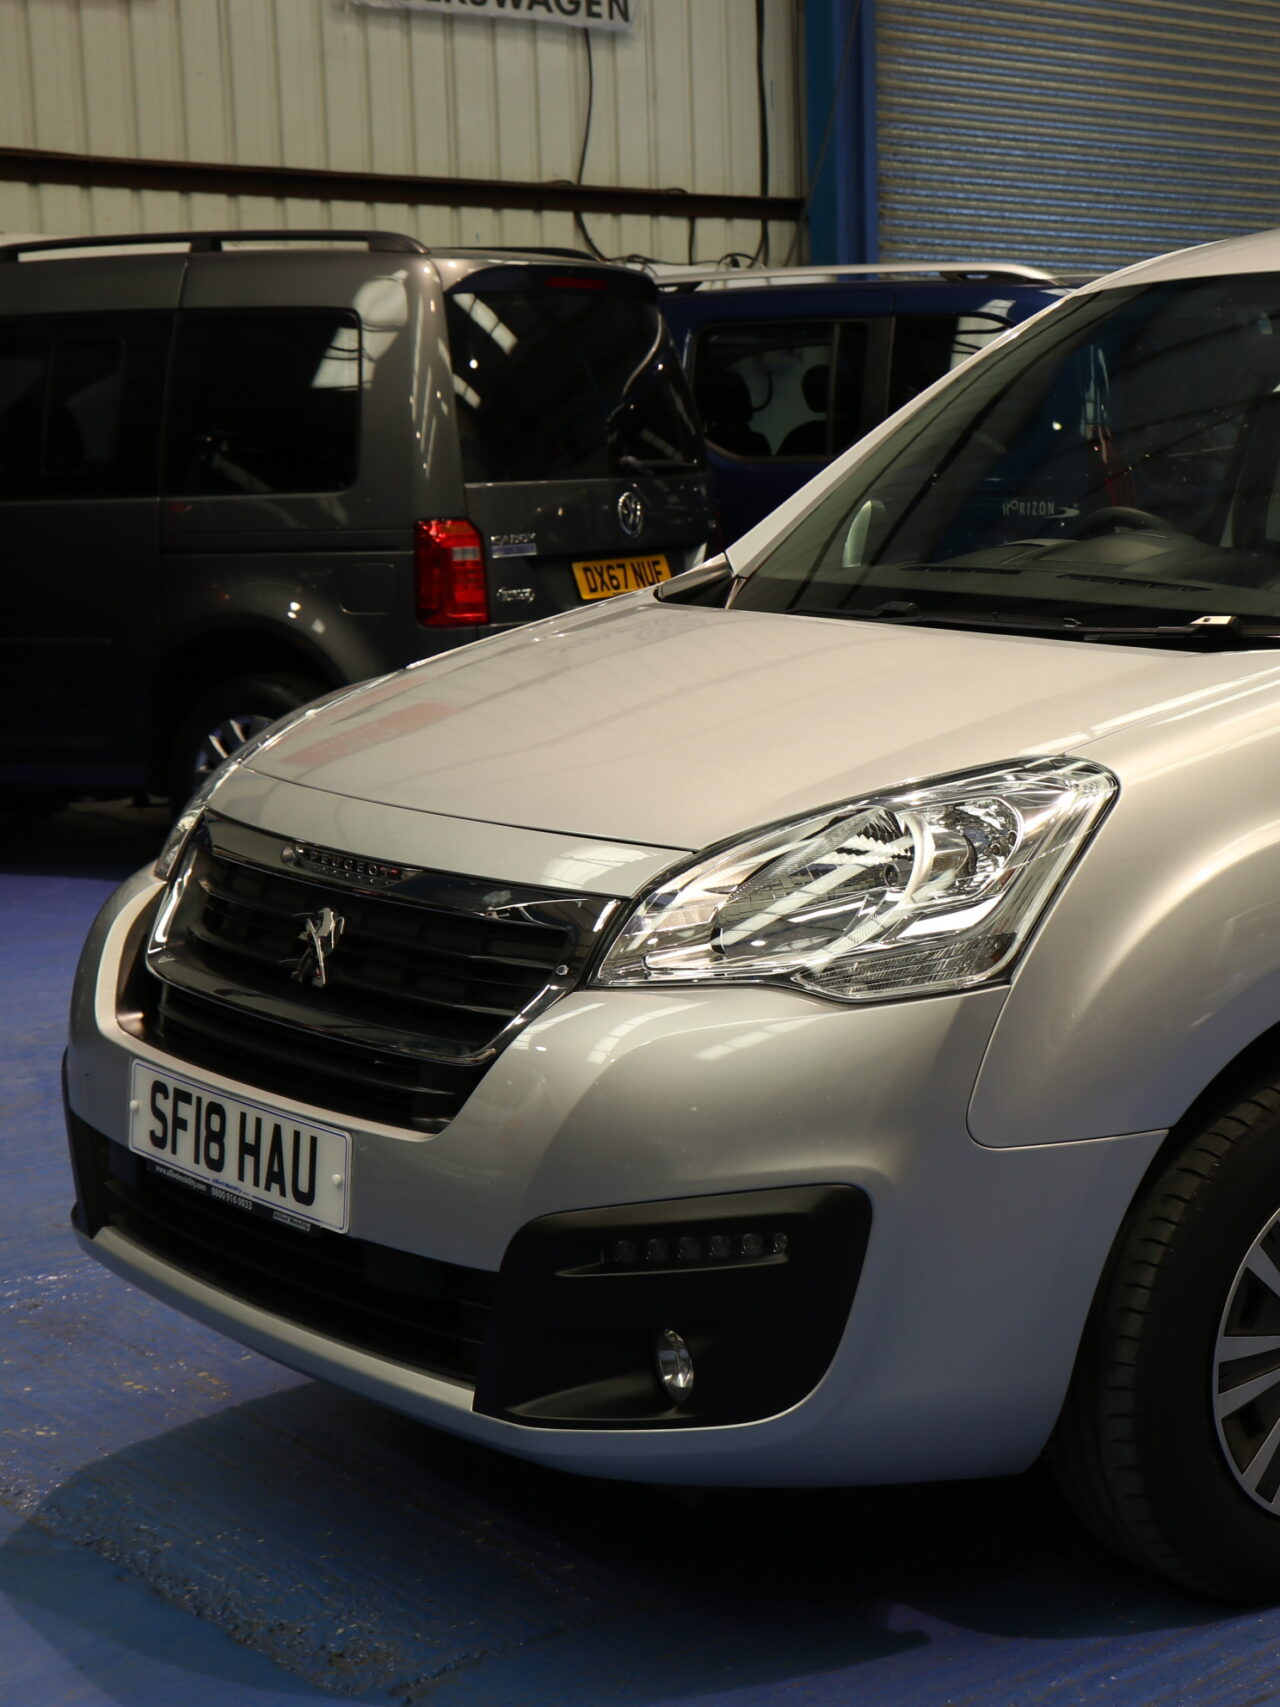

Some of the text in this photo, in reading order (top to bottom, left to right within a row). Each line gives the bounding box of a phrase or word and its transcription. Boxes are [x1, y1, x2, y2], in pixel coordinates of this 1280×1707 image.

[1002, 500, 1055, 516] HORIZON
[583, 563, 628, 593] DX67
[310, 850, 391, 878] PEUGEOT
[149, 1079, 318, 1207] SF18 HAU
